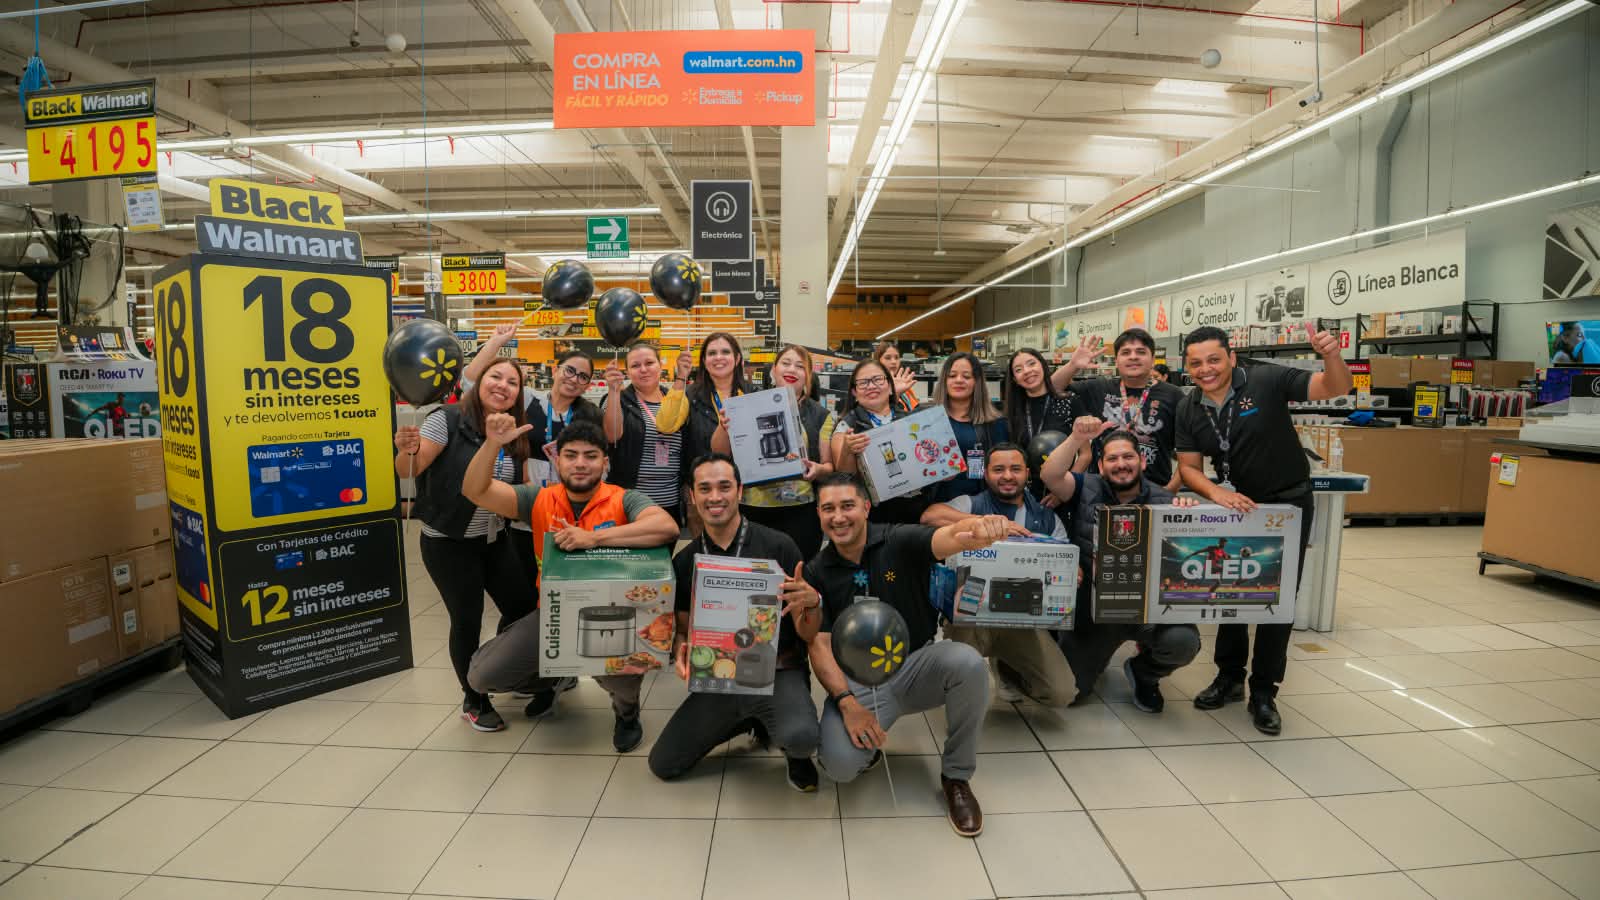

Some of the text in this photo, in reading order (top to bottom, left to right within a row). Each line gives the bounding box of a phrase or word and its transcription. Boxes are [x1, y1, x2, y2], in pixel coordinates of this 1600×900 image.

[573, 53, 660, 69] COMPRA
[689, 55, 796, 69] walmart.com.hn
[573, 71, 661, 91] EN LÍNEA
[32, 91, 148, 117] Black Walmart
[565, 92, 669, 108] FÁCIL Y RÁPIDO
[699, 95, 743, 105] Domicilio
[766, 91, 803, 104] Pickup
[43, 121, 151, 174] L 4195
[219, 184, 336, 226] Black
[204, 222, 358, 260] Walmart
[701, 231, 743, 239] Electrónica
[366, 261, 396, 269] Walmart
[445, 257, 502, 266] Black Walmart
[458, 272, 496, 292] 3800
[1357, 264, 1459, 293] Línea Blanca
[1198, 292, 1235, 309] Cocina y
[243, 275, 355, 364] 18
[1198, 311, 1239, 326] Comedor
[158, 281, 189, 398] 18
[59, 368, 144, 380] RCA Roku TV
[244, 366, 360, 390] meses
[245, 391, 360, 409] sin intereses
[162, 403, 195, 435] meses
[224, 415, 231, 427] y
[235, 412, 249, 424] te
[252, 410, 332, 424] devolvemos
[334, 408, 340, 419] 1
[84, 418, 161, 438] QLED
[262, 434, 297, 443] Pagando
[324, 431, 350, 439] Tarjeta
[252, 443, 361, 460] Walmart BAC
[1163, 514, 1192, 523] RCA
[1200, 514, 1227, 523] Roku
[1231, 514, 1245, 523] TV
[257, 528, 369, 553] Con Tarjetas de Crédito
[330, 543, 355, 559] BAC
[962, 549, 997, 559] EPSON
[1181, 559, 1262, 580] QLED
[248, 580, 268, 589] Hasta
[706, 578, 764, 589] BLACK+DECKER
[241, 580, 345, 626] 12 meses
[294, 586, 391, 617] sin intereses
[545, 590, 561, 660] Cuisinart
[257, 639, 286, 652] Compra
[272, 648, 281, 656] en
[282, 641, 316, 655] productos
[317, 630, 362, 644] seleccionados
